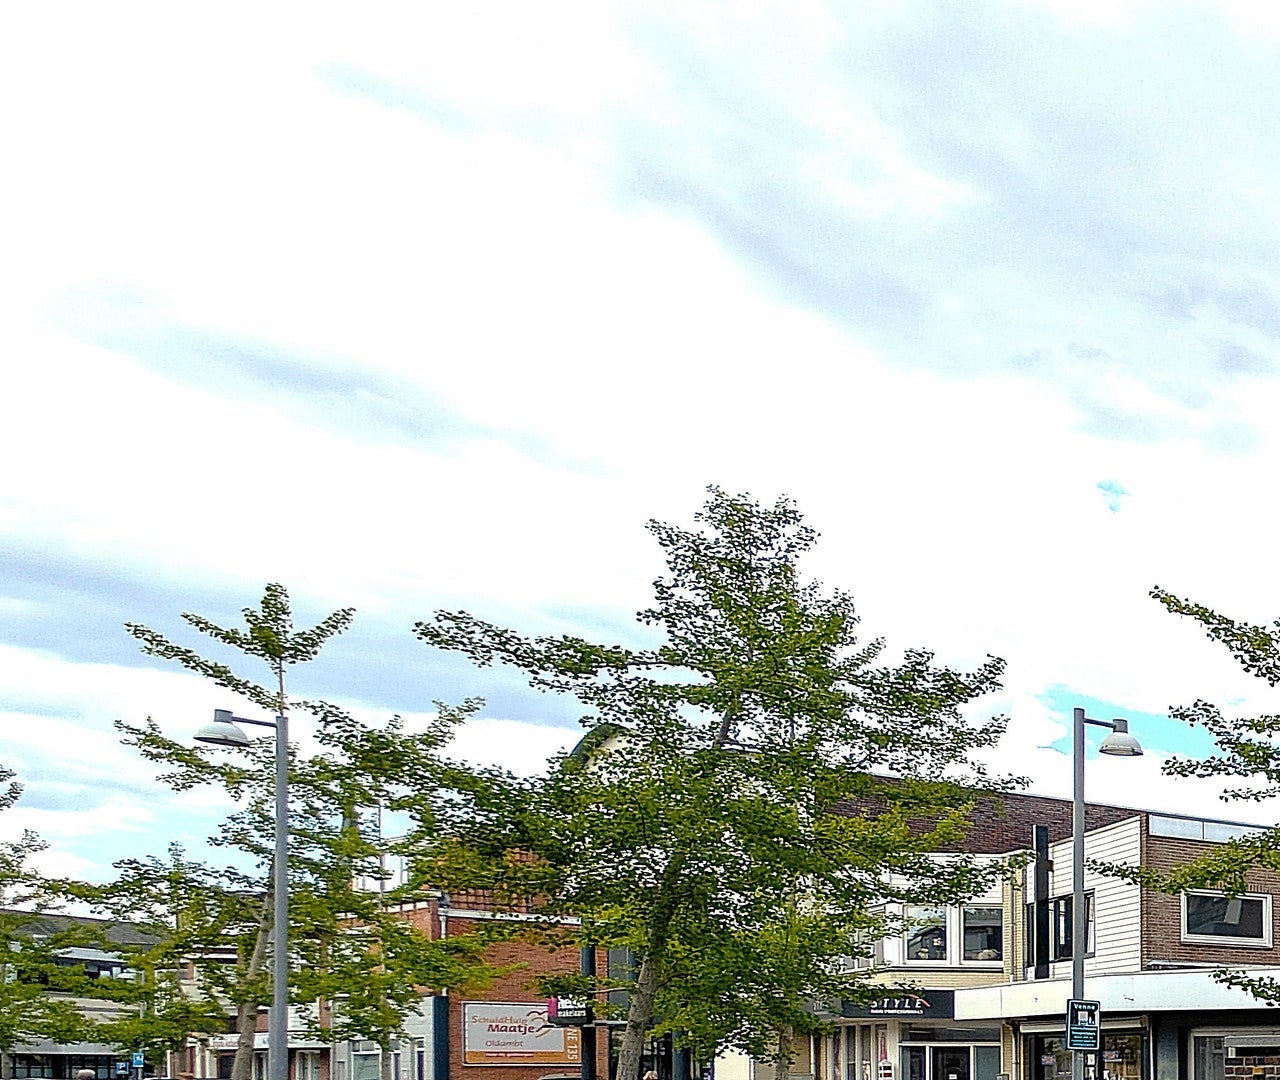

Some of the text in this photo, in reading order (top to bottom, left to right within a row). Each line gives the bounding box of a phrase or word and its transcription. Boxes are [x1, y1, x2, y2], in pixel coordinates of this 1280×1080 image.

[870, 998, 922, 1008] STYLE
[487, 1024, 535, 1035] Maatje
[567, 1044, 578, 1060] 135
